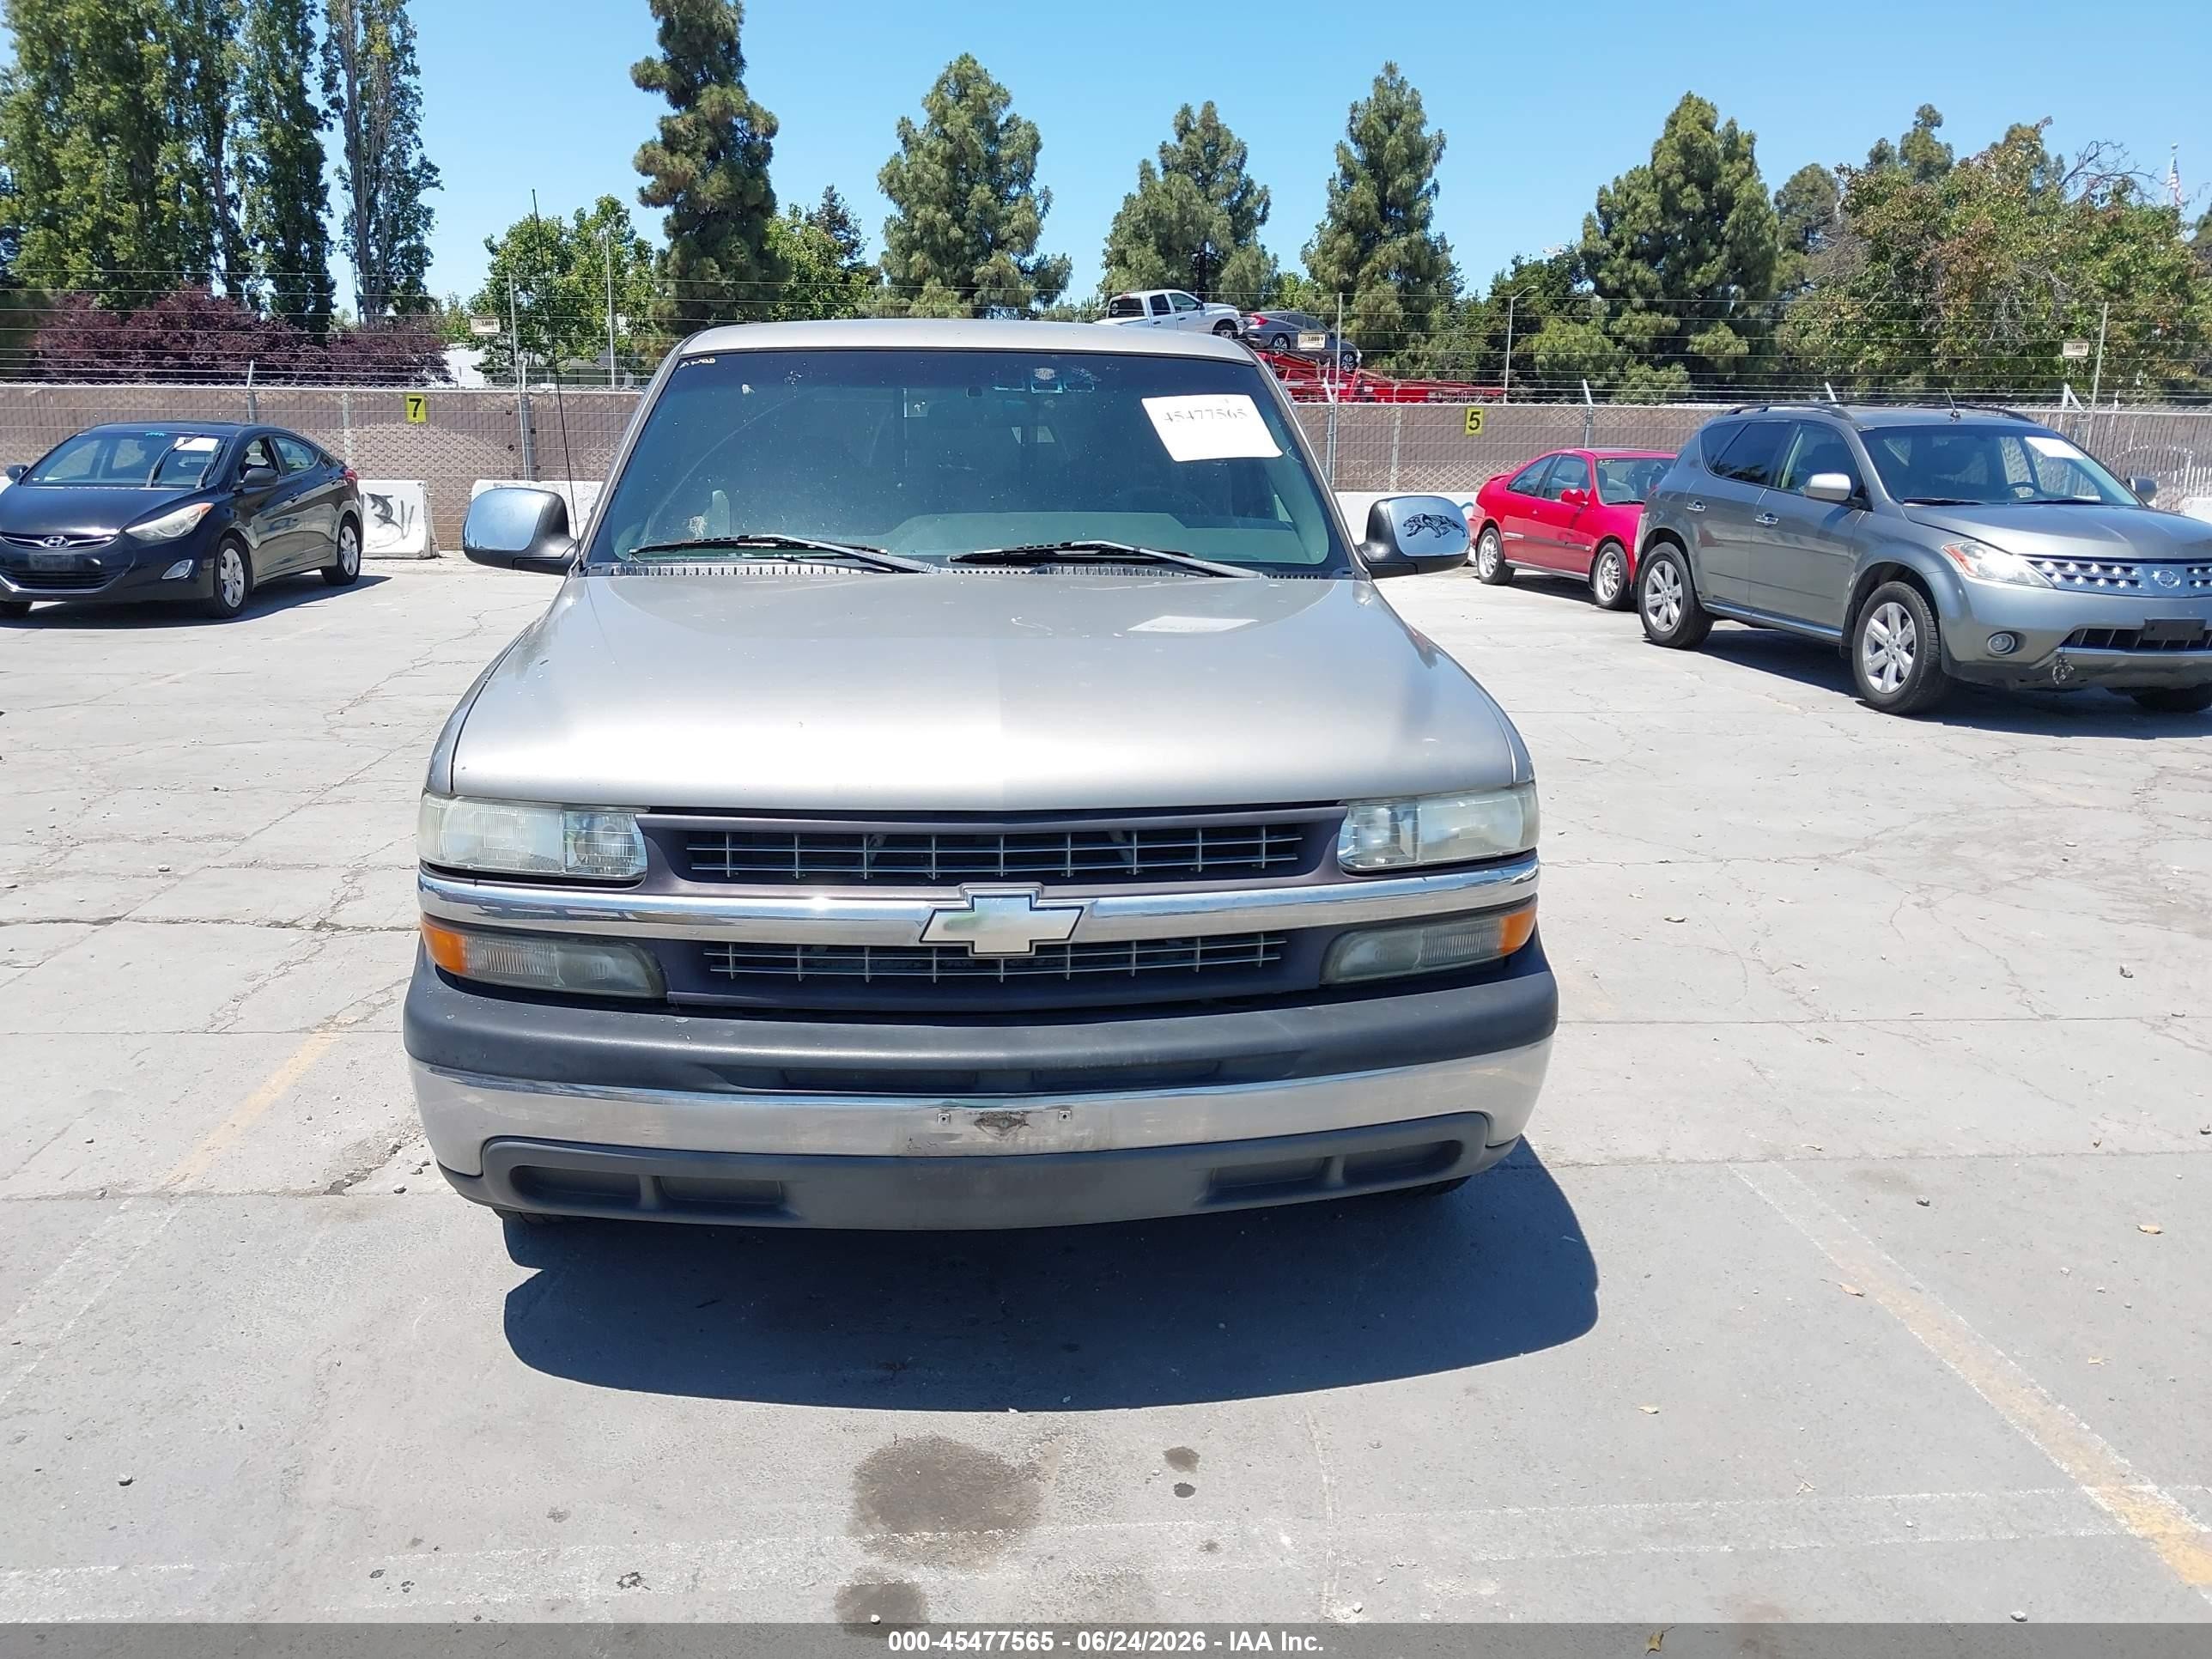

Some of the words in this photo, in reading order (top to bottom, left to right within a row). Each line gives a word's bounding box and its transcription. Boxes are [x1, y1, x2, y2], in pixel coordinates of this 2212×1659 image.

[408, 398, 422, 418] 7
[1164, 408, 1249, 422] 45477565
[1468, 411, 1481, 430] 5
